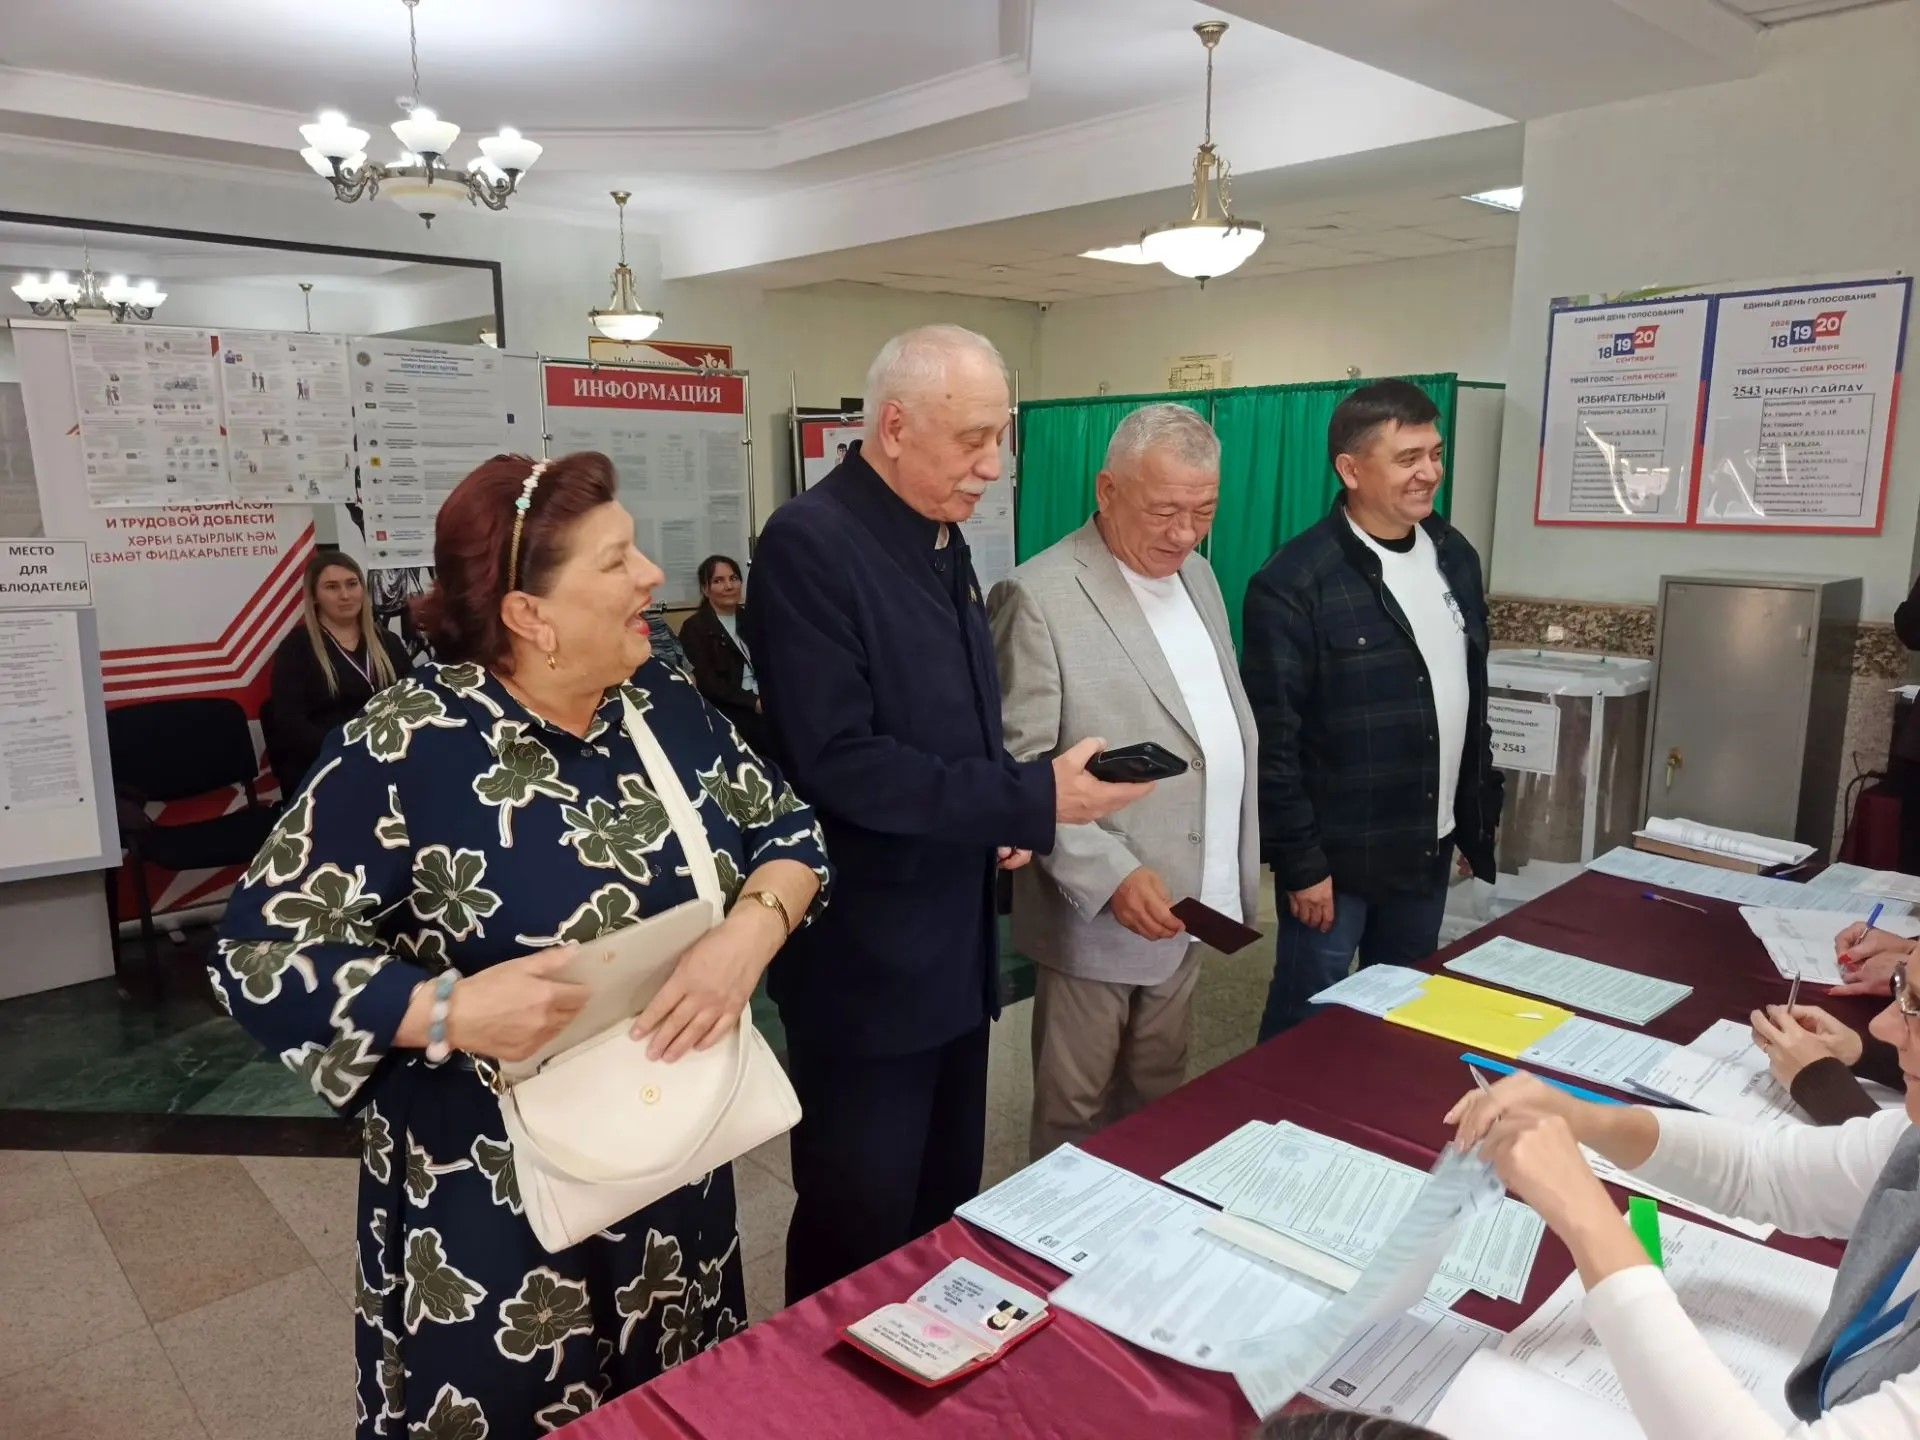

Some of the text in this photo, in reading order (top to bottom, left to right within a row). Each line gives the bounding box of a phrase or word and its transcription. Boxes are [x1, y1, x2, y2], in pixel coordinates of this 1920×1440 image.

[1743, 292, 1876, 310] ЕДИНЫЙ ДЕНЬ ГОЛОСОВАНИЯ
[1627, 308, 1684, 319] ГОЛОСОВАНИЯ
[1770, 317, 1840, 349] 18 19 20
[1598, 331, 1654, 359] 18 19 20
[1792, 344, 1840, 354] СЕНТЯБРЯ
[1761, 366, 1790, 375] ГОЛОС
[1800, 365, 1824, 373] СИЛА
[573, 378, 722, 404] ИНФОРМАЦИЯ
[1577, 391, 1666, 404] ИЗБИРАТЕЛЬНЫЙ
[1732, 386, 1760, 397] 2543
[106, 514, 275, 530] И ТРУДОВОЙ ДОБЛЕСТИ
[128, 536, 173, 547] ХӘРБИ
[177, 533, 244, 544] БАТЫРЛЫК
[9, 546, 55, 556] МЕСТО
[146, 547, 249, 561] ФИДАКАРЬЛЕГЕ
[252, 546, 278, 556] ЕЛЫ
[19, 565, 48, 576] ДЛЯ
[0, 580, 88, 594] БЛЮДАТЕЛЕЙ
[1501, 742, 1526, 754] 2543
